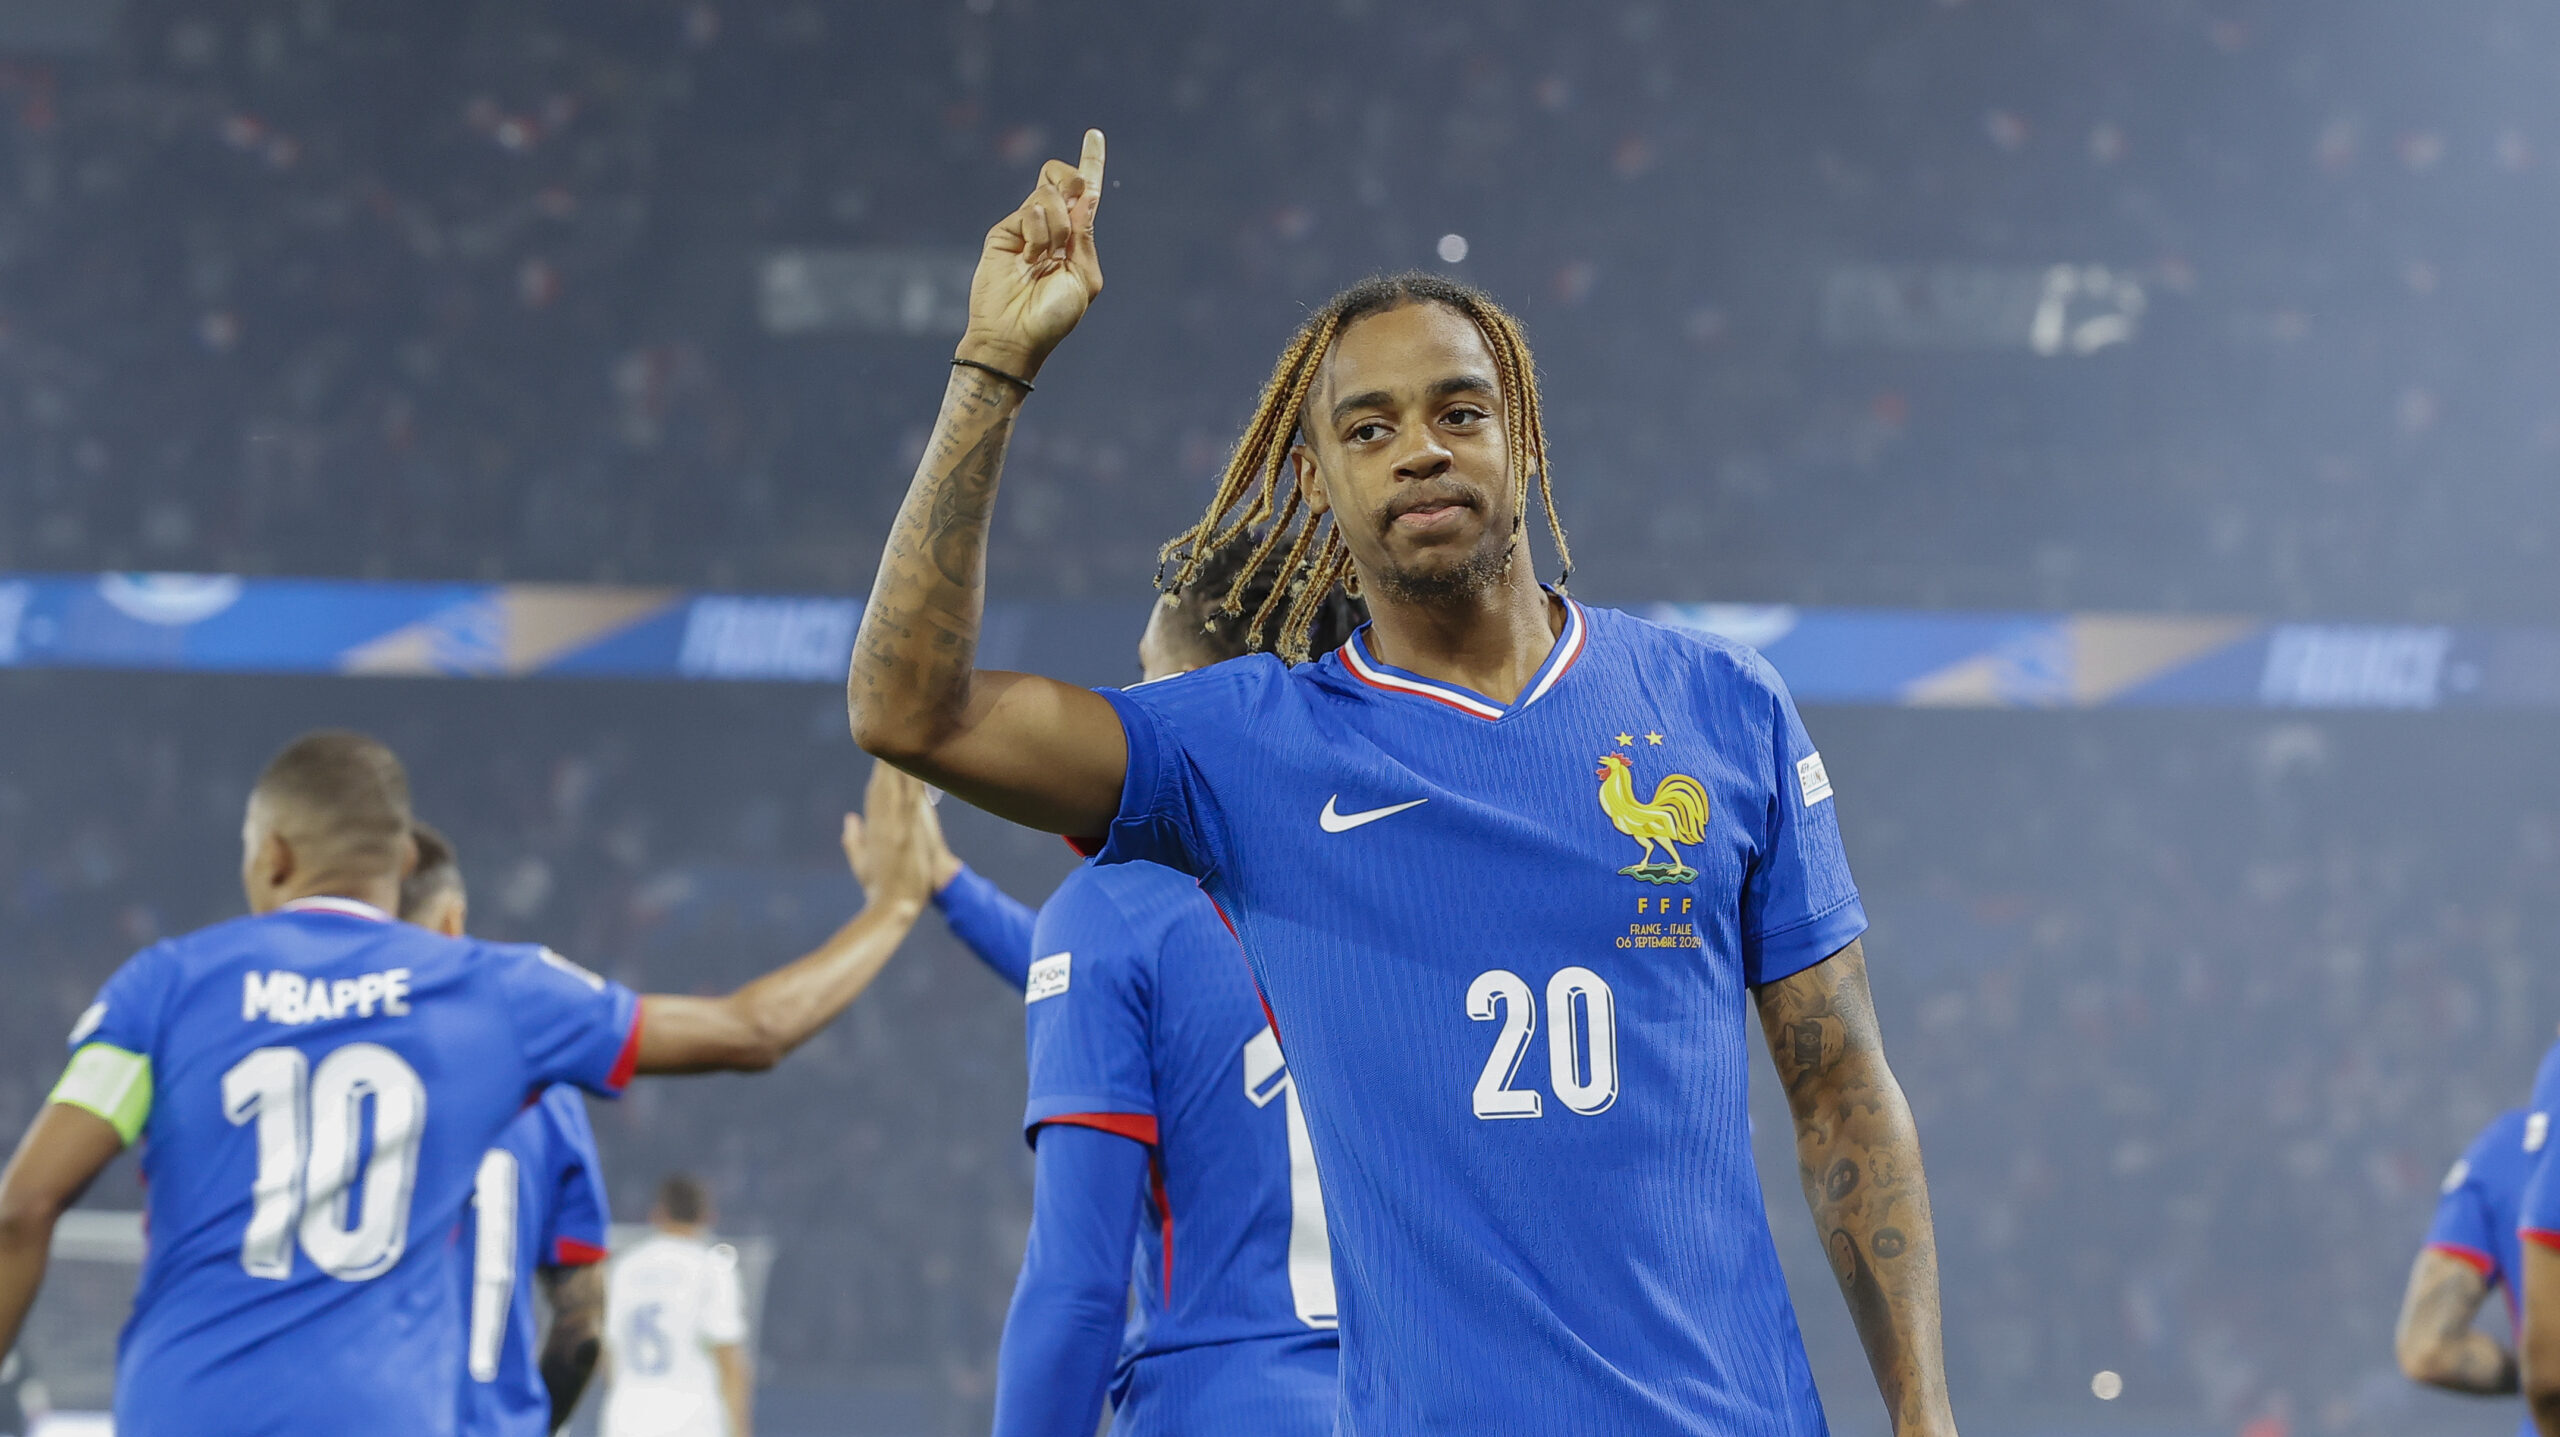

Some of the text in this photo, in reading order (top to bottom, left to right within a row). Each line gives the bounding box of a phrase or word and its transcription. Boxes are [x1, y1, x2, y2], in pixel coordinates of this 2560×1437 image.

[1616, 936, 1702, 948] 06 SEPTEMBRE 2024
[1630, 923, 1661, 935] FRANCE
[1670, 923, 1692, 935] ITALIE
[243, 967, 411, 1025] MBAPPE
[1466, 966, 1619, 1119] 20
[222, 1042, 427, 1282] 10
